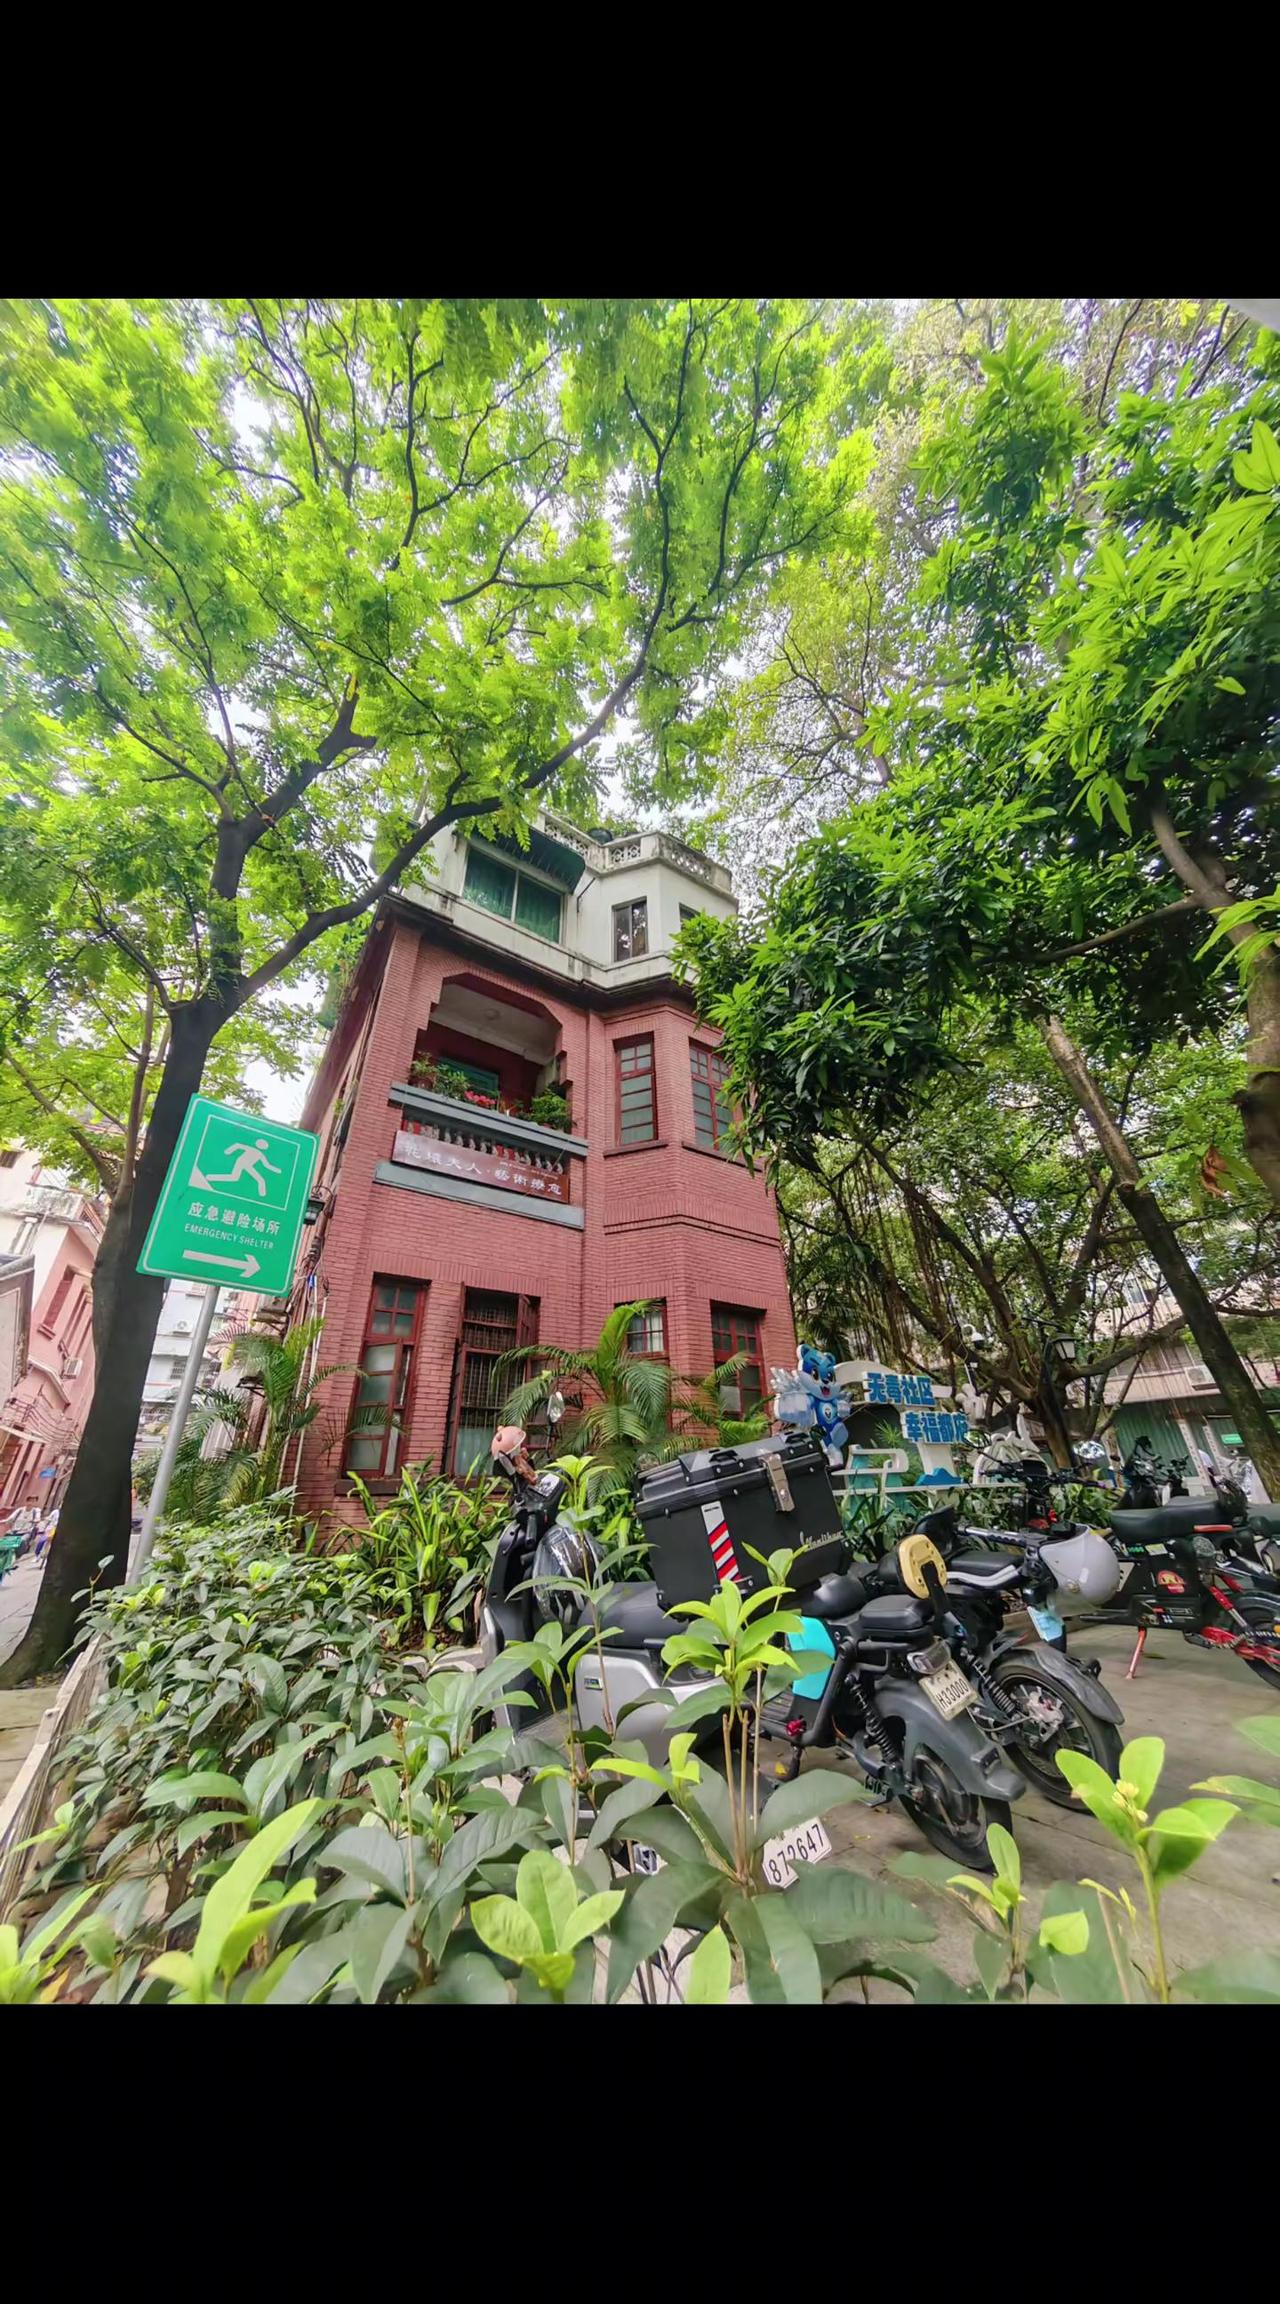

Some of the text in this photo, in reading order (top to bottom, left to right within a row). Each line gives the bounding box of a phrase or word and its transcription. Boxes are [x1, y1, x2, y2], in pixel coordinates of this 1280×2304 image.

[184, 1222, 275, 1249] EMERGENCY SHELTER
[187, 1201, 281, 1236] 应急避险场所
[864, 1371, 937, 1407] 无毒社区
[768, 1823, 824, 1884] 872647
